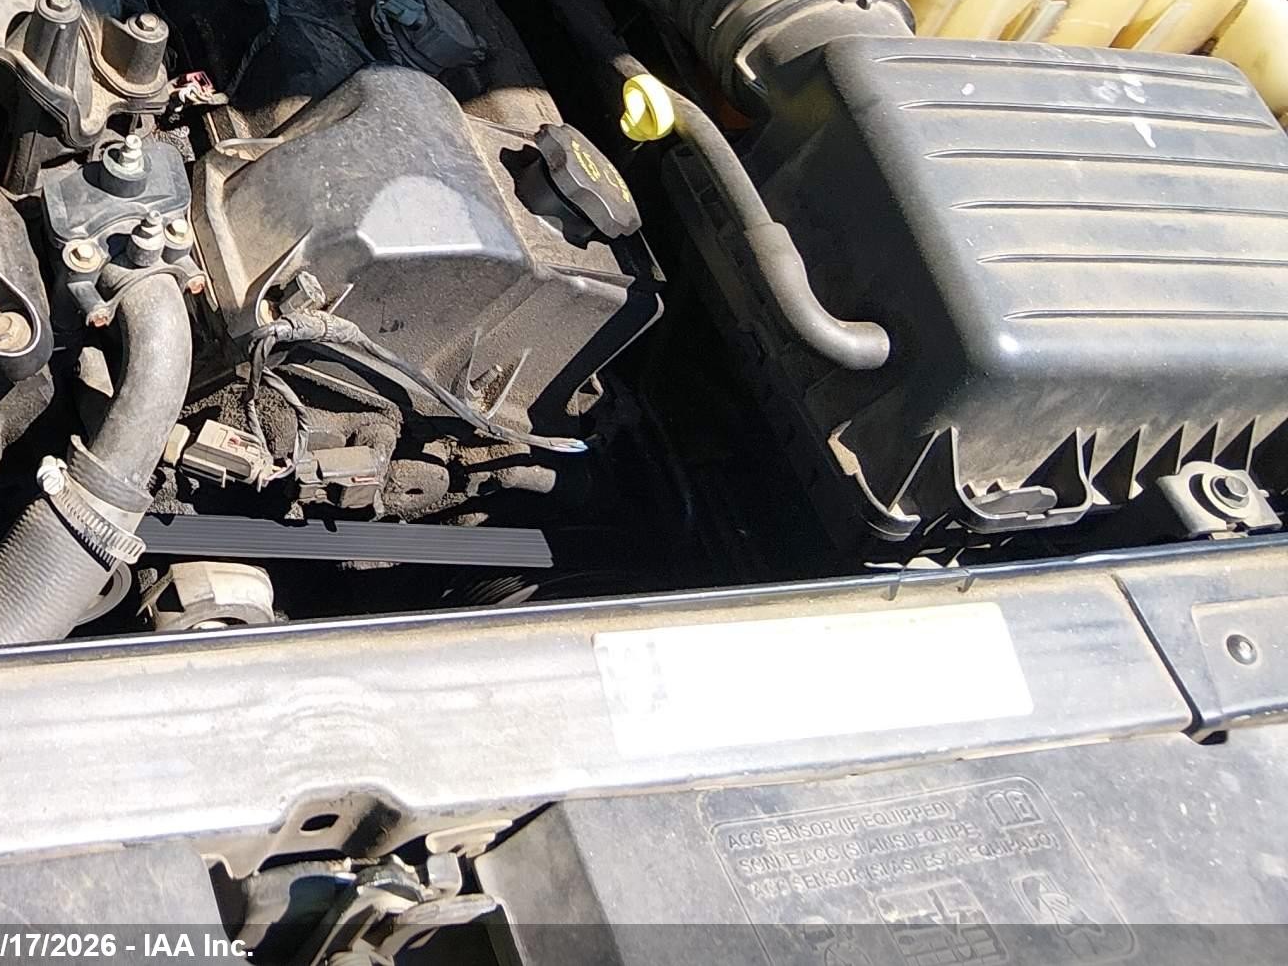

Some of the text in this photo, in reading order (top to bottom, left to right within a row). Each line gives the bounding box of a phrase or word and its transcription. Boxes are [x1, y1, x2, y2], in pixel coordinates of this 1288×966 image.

[727, 801, 953, 849] ACC SENSOR (IF EQUIPPED)
[790, 866, 866, 891] SENSOR
[965, 832, 1059, 859] EQUIPADO)
[803, 845, 839, 865] ACC
